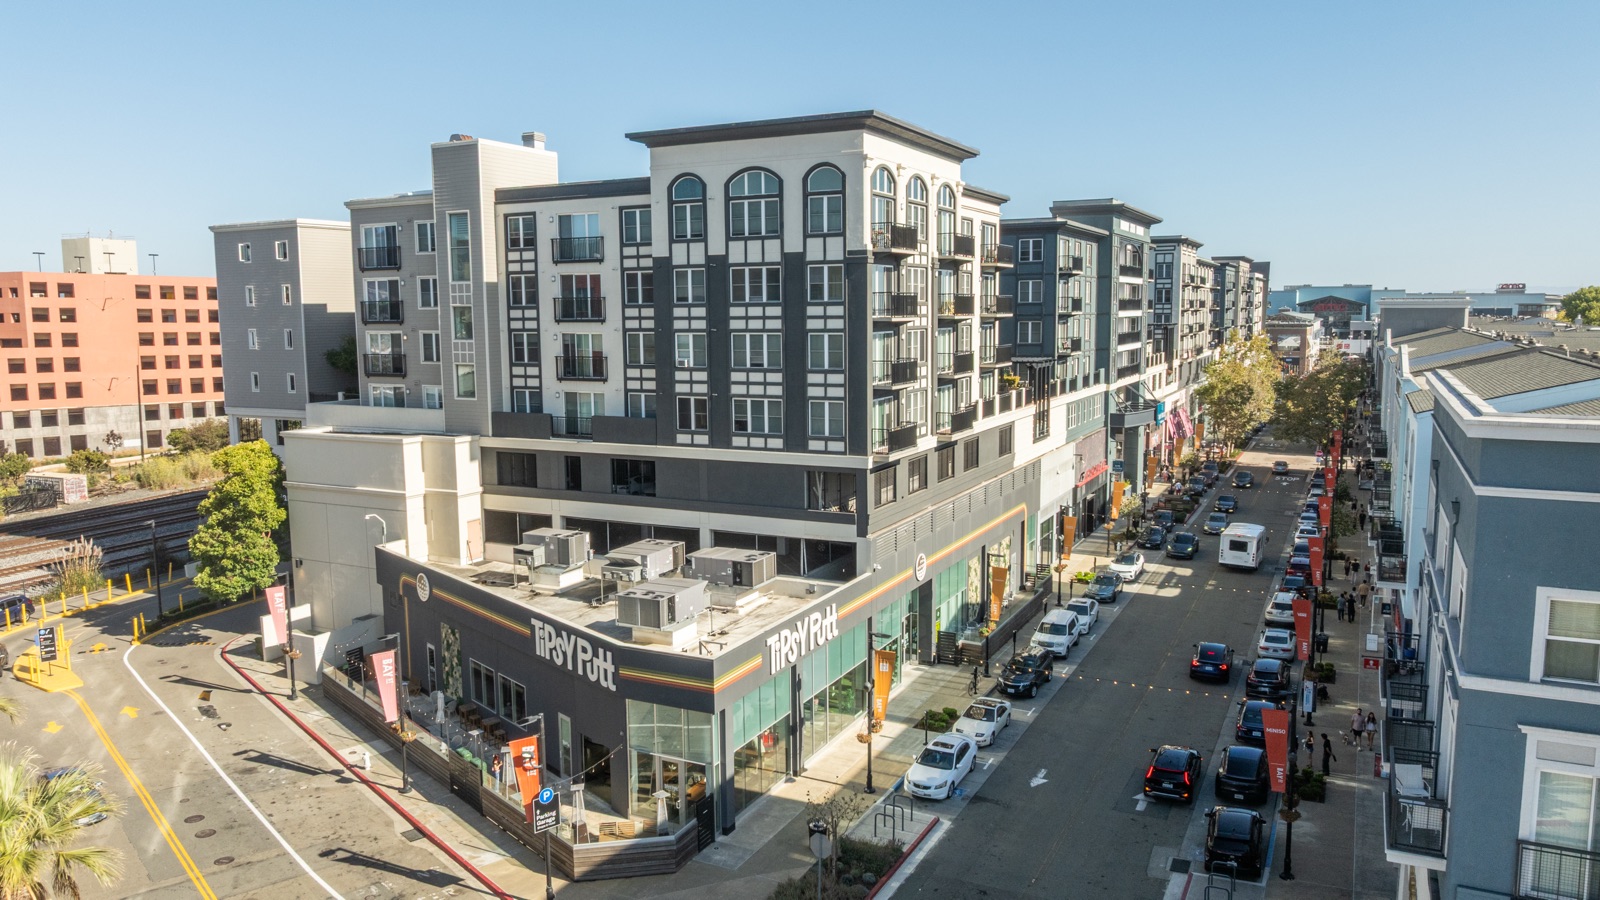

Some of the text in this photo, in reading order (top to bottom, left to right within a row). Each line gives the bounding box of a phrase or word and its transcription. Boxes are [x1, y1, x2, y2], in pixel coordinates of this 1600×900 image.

[274, 592, 284, 608] BAY
[382, 658, 394, 677] BAY
[543, 791, 550, 801] P
[536, 810, 556, 820] Parking
[536, 816, 556, 826] Garage
